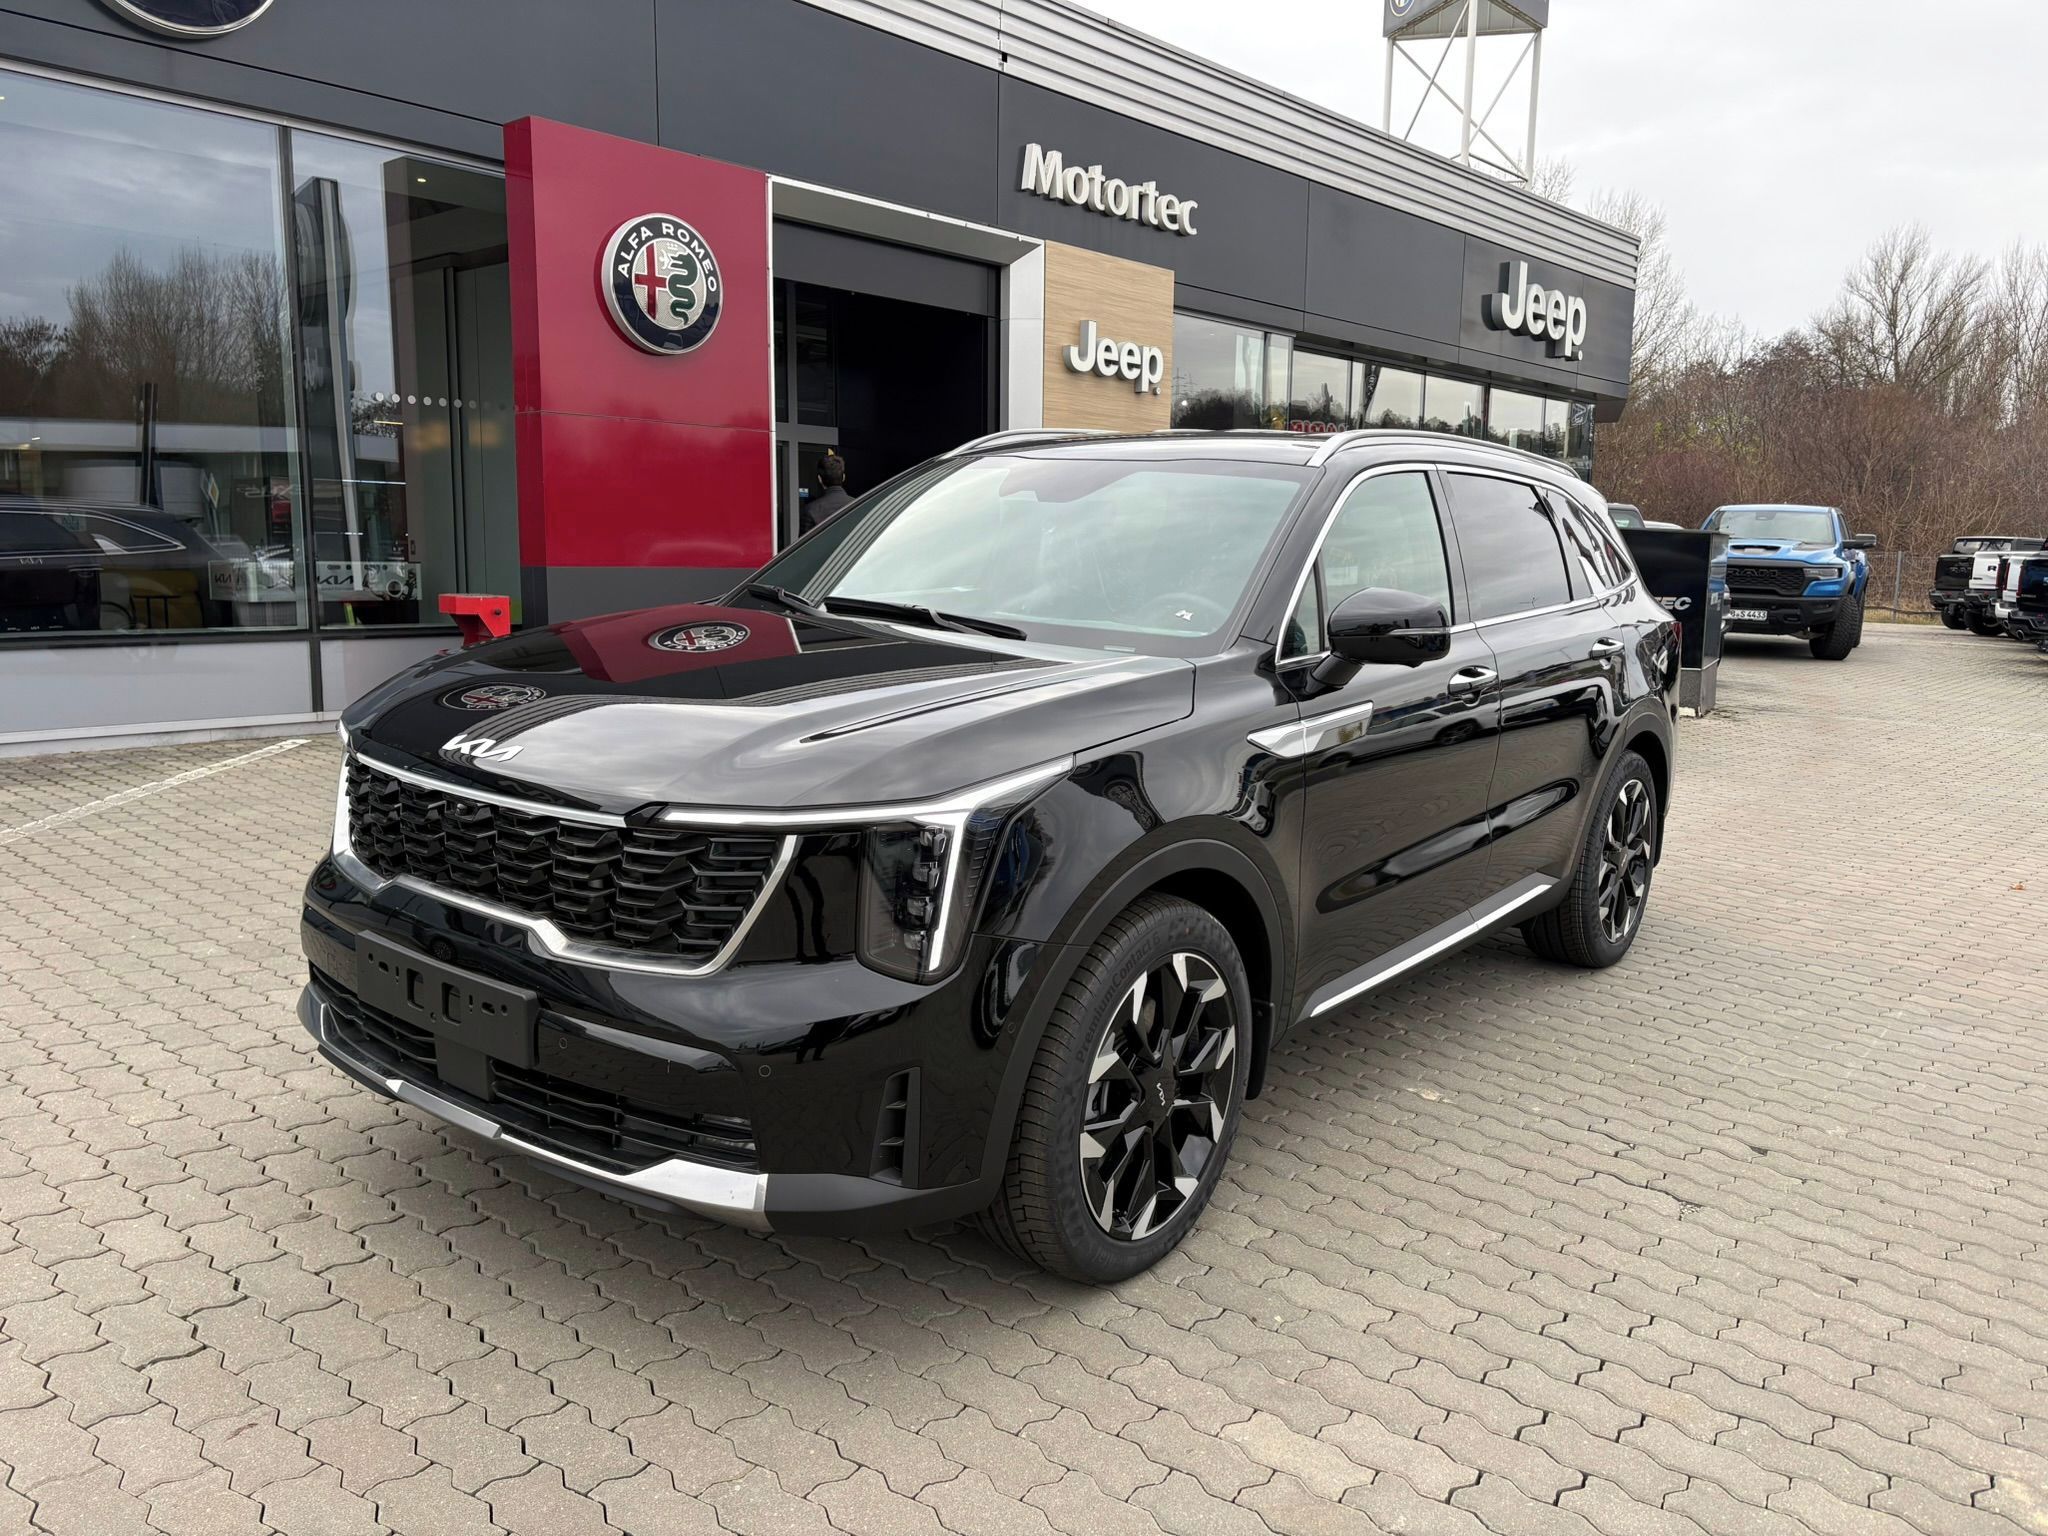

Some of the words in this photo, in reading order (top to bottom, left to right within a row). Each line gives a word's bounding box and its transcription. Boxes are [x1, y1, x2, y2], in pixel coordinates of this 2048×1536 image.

[1021, 143, 1199, 236] Motortec
[617, 225, 654, 279] ALFA
[661, 222, 717, 293] ROMEO
[1493, 260, 1587, 359] Jeep
[1064, 320, 1164, 394] Jeep
[442, 734, 524, 762] KIA
[1076, 941, 1153, 1063] PremiumContact
